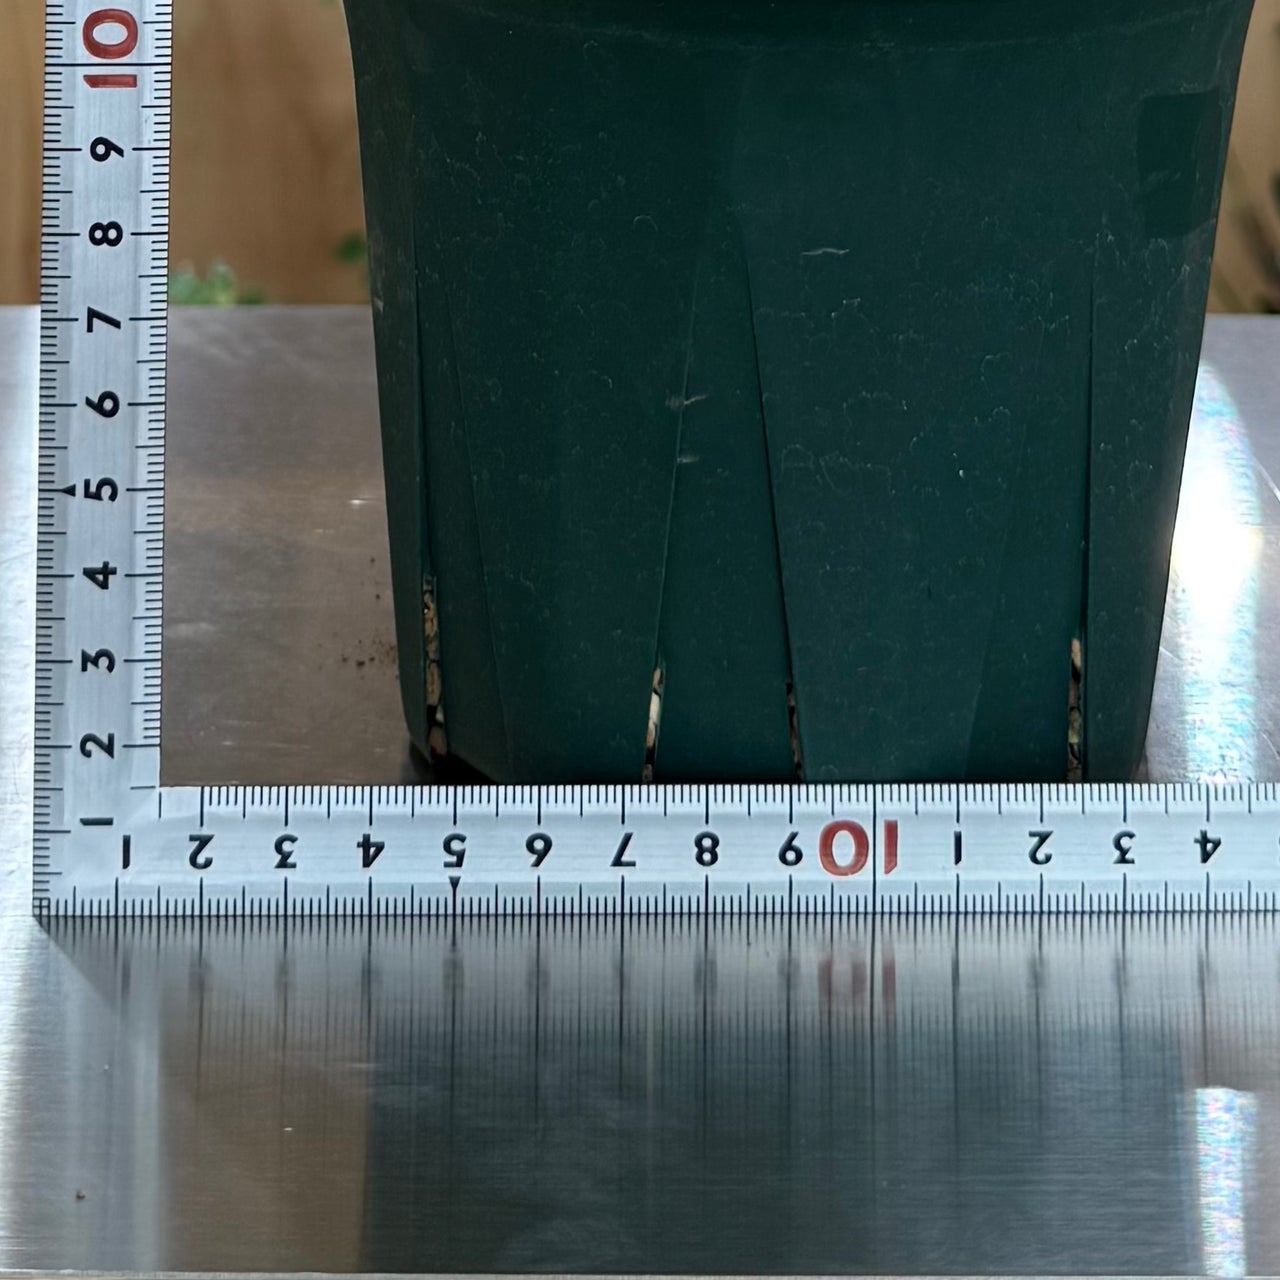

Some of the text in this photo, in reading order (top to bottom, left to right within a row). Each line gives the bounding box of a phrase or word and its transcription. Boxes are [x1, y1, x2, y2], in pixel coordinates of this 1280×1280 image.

[82, 8, 139, 89] 10
[89, 136, 125, 163] 9
[88, 220, 124, 248] 8
[86, 305, 122, 334] 7
[84, 390, 121, 419] 6
[83, 477, 119, 503] 5
[82, 560, 118, 591] 4
[80, 648, 116, 674] 3
[79, 732, 115, 760] 2
[79, 817, 114, 827] 1
[122, 834, 131, 870] 1
[188, 834, 215, 870] 2
[274, 834, 299, 870] 3
[356, 833, 386, 869] 4
[442, 833, 467, 869] 5
[525, 832, 553, 868] 6
[610, 832, 637, 868] 7
[694, 831, 720, 867] 8
[778, 831, 804, 867] 9
[818, 818, 900, 877] 10
[953, 831, 963, 866] 1
[1028, 830, 1054, 866] 2
[1112, 831, 1137, 865] 3
[1193, 830, 1222, 864] 4
